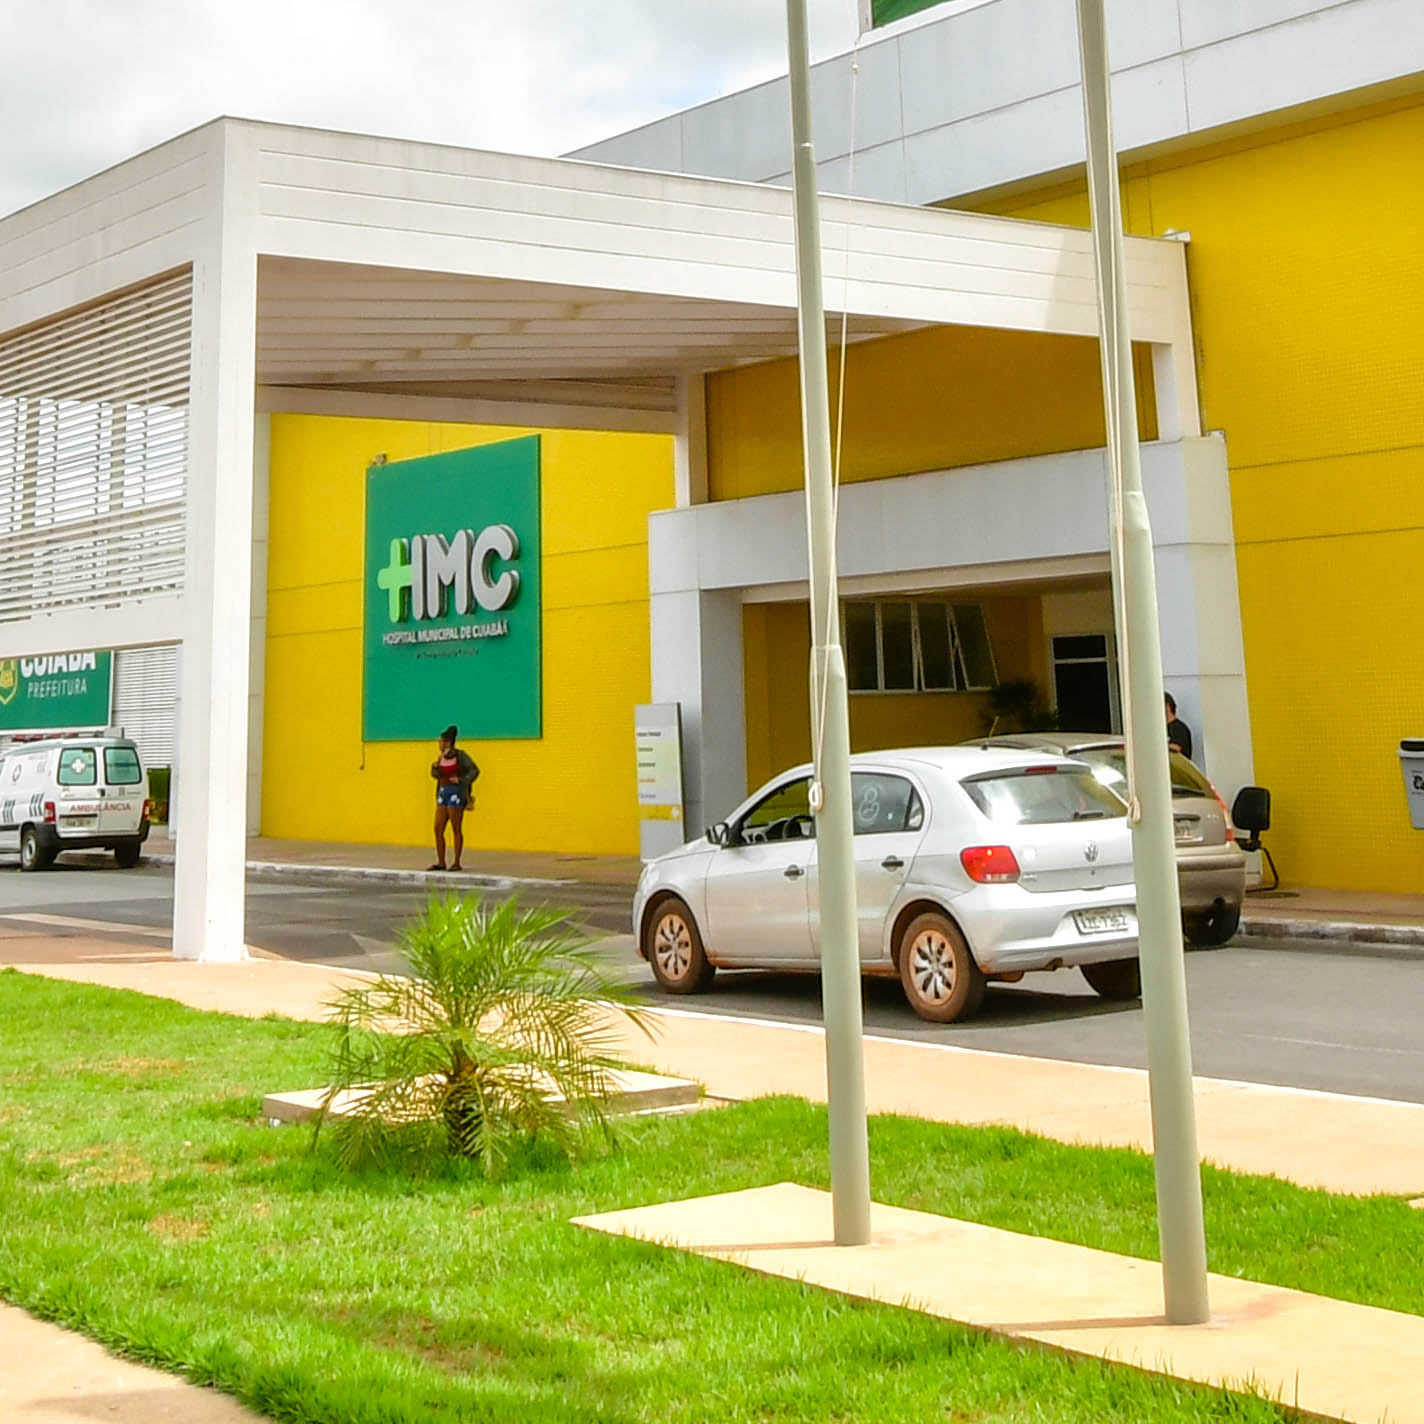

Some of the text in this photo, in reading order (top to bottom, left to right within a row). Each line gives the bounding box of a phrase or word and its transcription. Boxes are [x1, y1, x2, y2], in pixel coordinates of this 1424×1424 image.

[383, 631, 417, 646] HOSPITAL
[418, 627, 459, 643] MUNICIPAL
[460, 625, 472, 639] DE
[27, 677, 87, 698] PREFEITURA
[70, 802, 132, 812] AMBULÂNCIA
